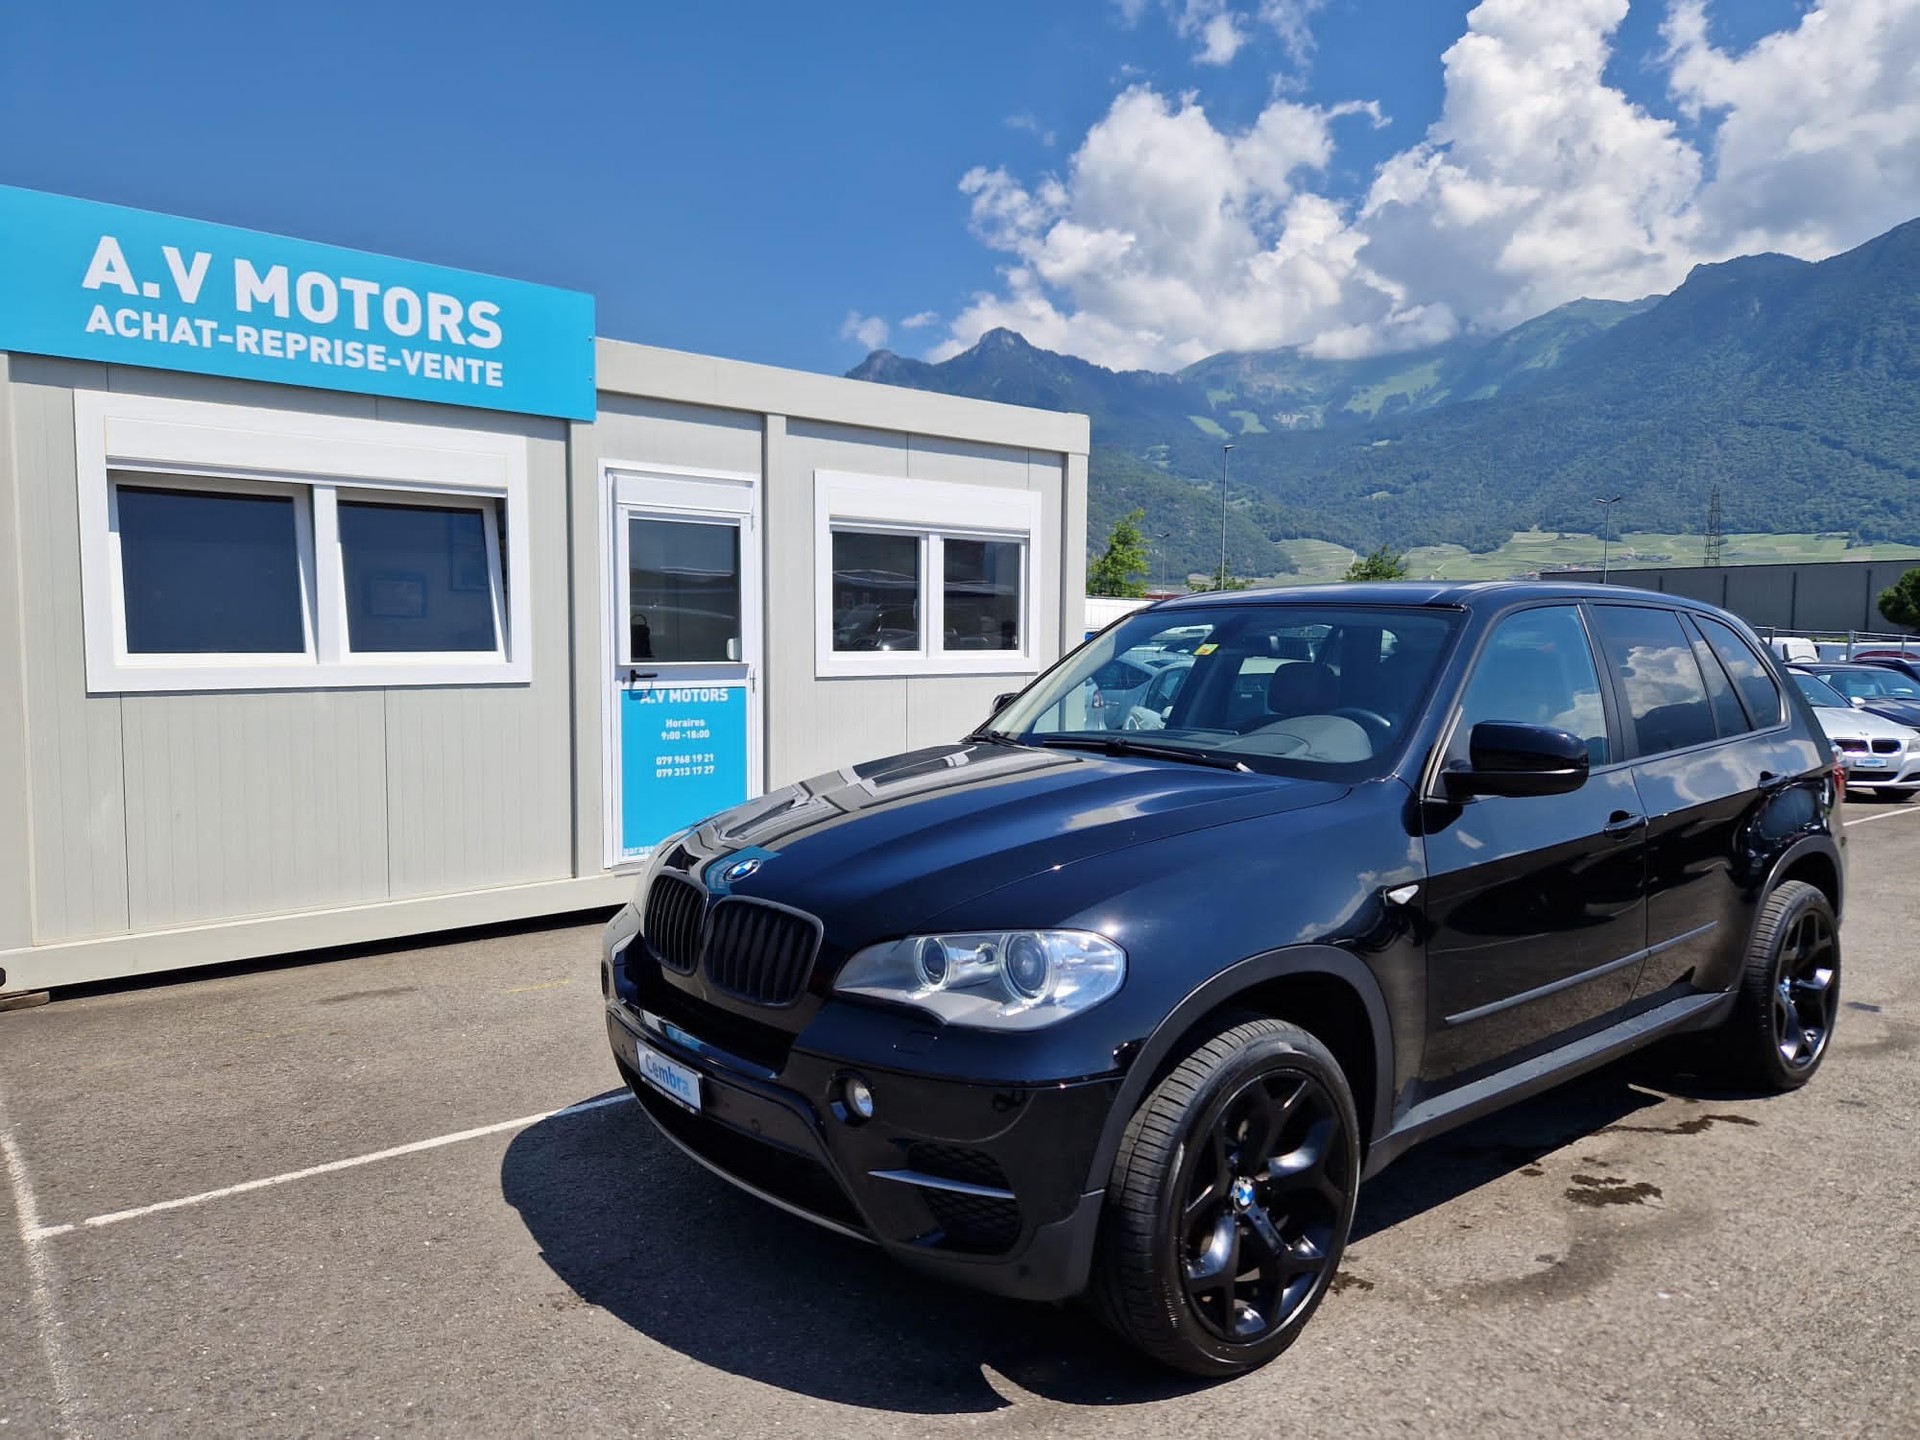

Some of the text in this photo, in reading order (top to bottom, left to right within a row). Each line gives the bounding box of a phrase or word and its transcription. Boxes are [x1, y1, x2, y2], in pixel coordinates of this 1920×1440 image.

[82, 235, 503, 349] A.V MOTORS
[669, 688, 729, 703] MOTORS
[665, 718, 705, 728] Horaires
[645, 1053, 691, 1097] Cembra
